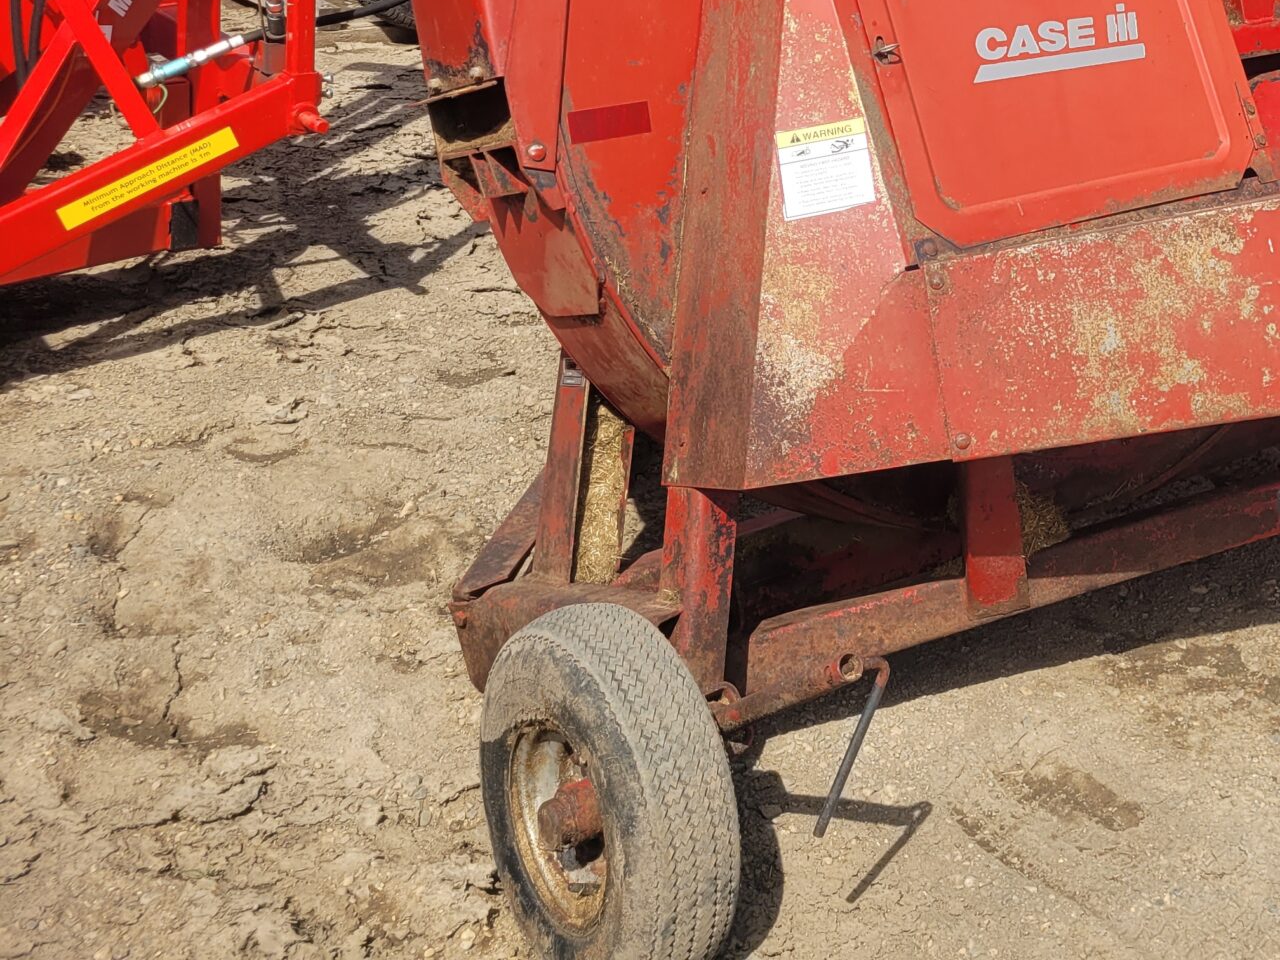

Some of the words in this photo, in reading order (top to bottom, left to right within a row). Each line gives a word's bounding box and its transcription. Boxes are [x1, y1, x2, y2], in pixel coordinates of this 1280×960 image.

[975, 16, 1096, 61] CASE
[802, 124, 852, 141] WARNING
[83, 187, 118, 207] Minimum
[119, 169, 155, 190] Approach
[156, 153, 188, 172] Distance
[189, 141, 212, 157] (MAD)
[91, 201, 111, 213] from
[112, 192, 125, 205] the
[126, 177, 157, 195] working
[158, 162, 189, 178] machine
